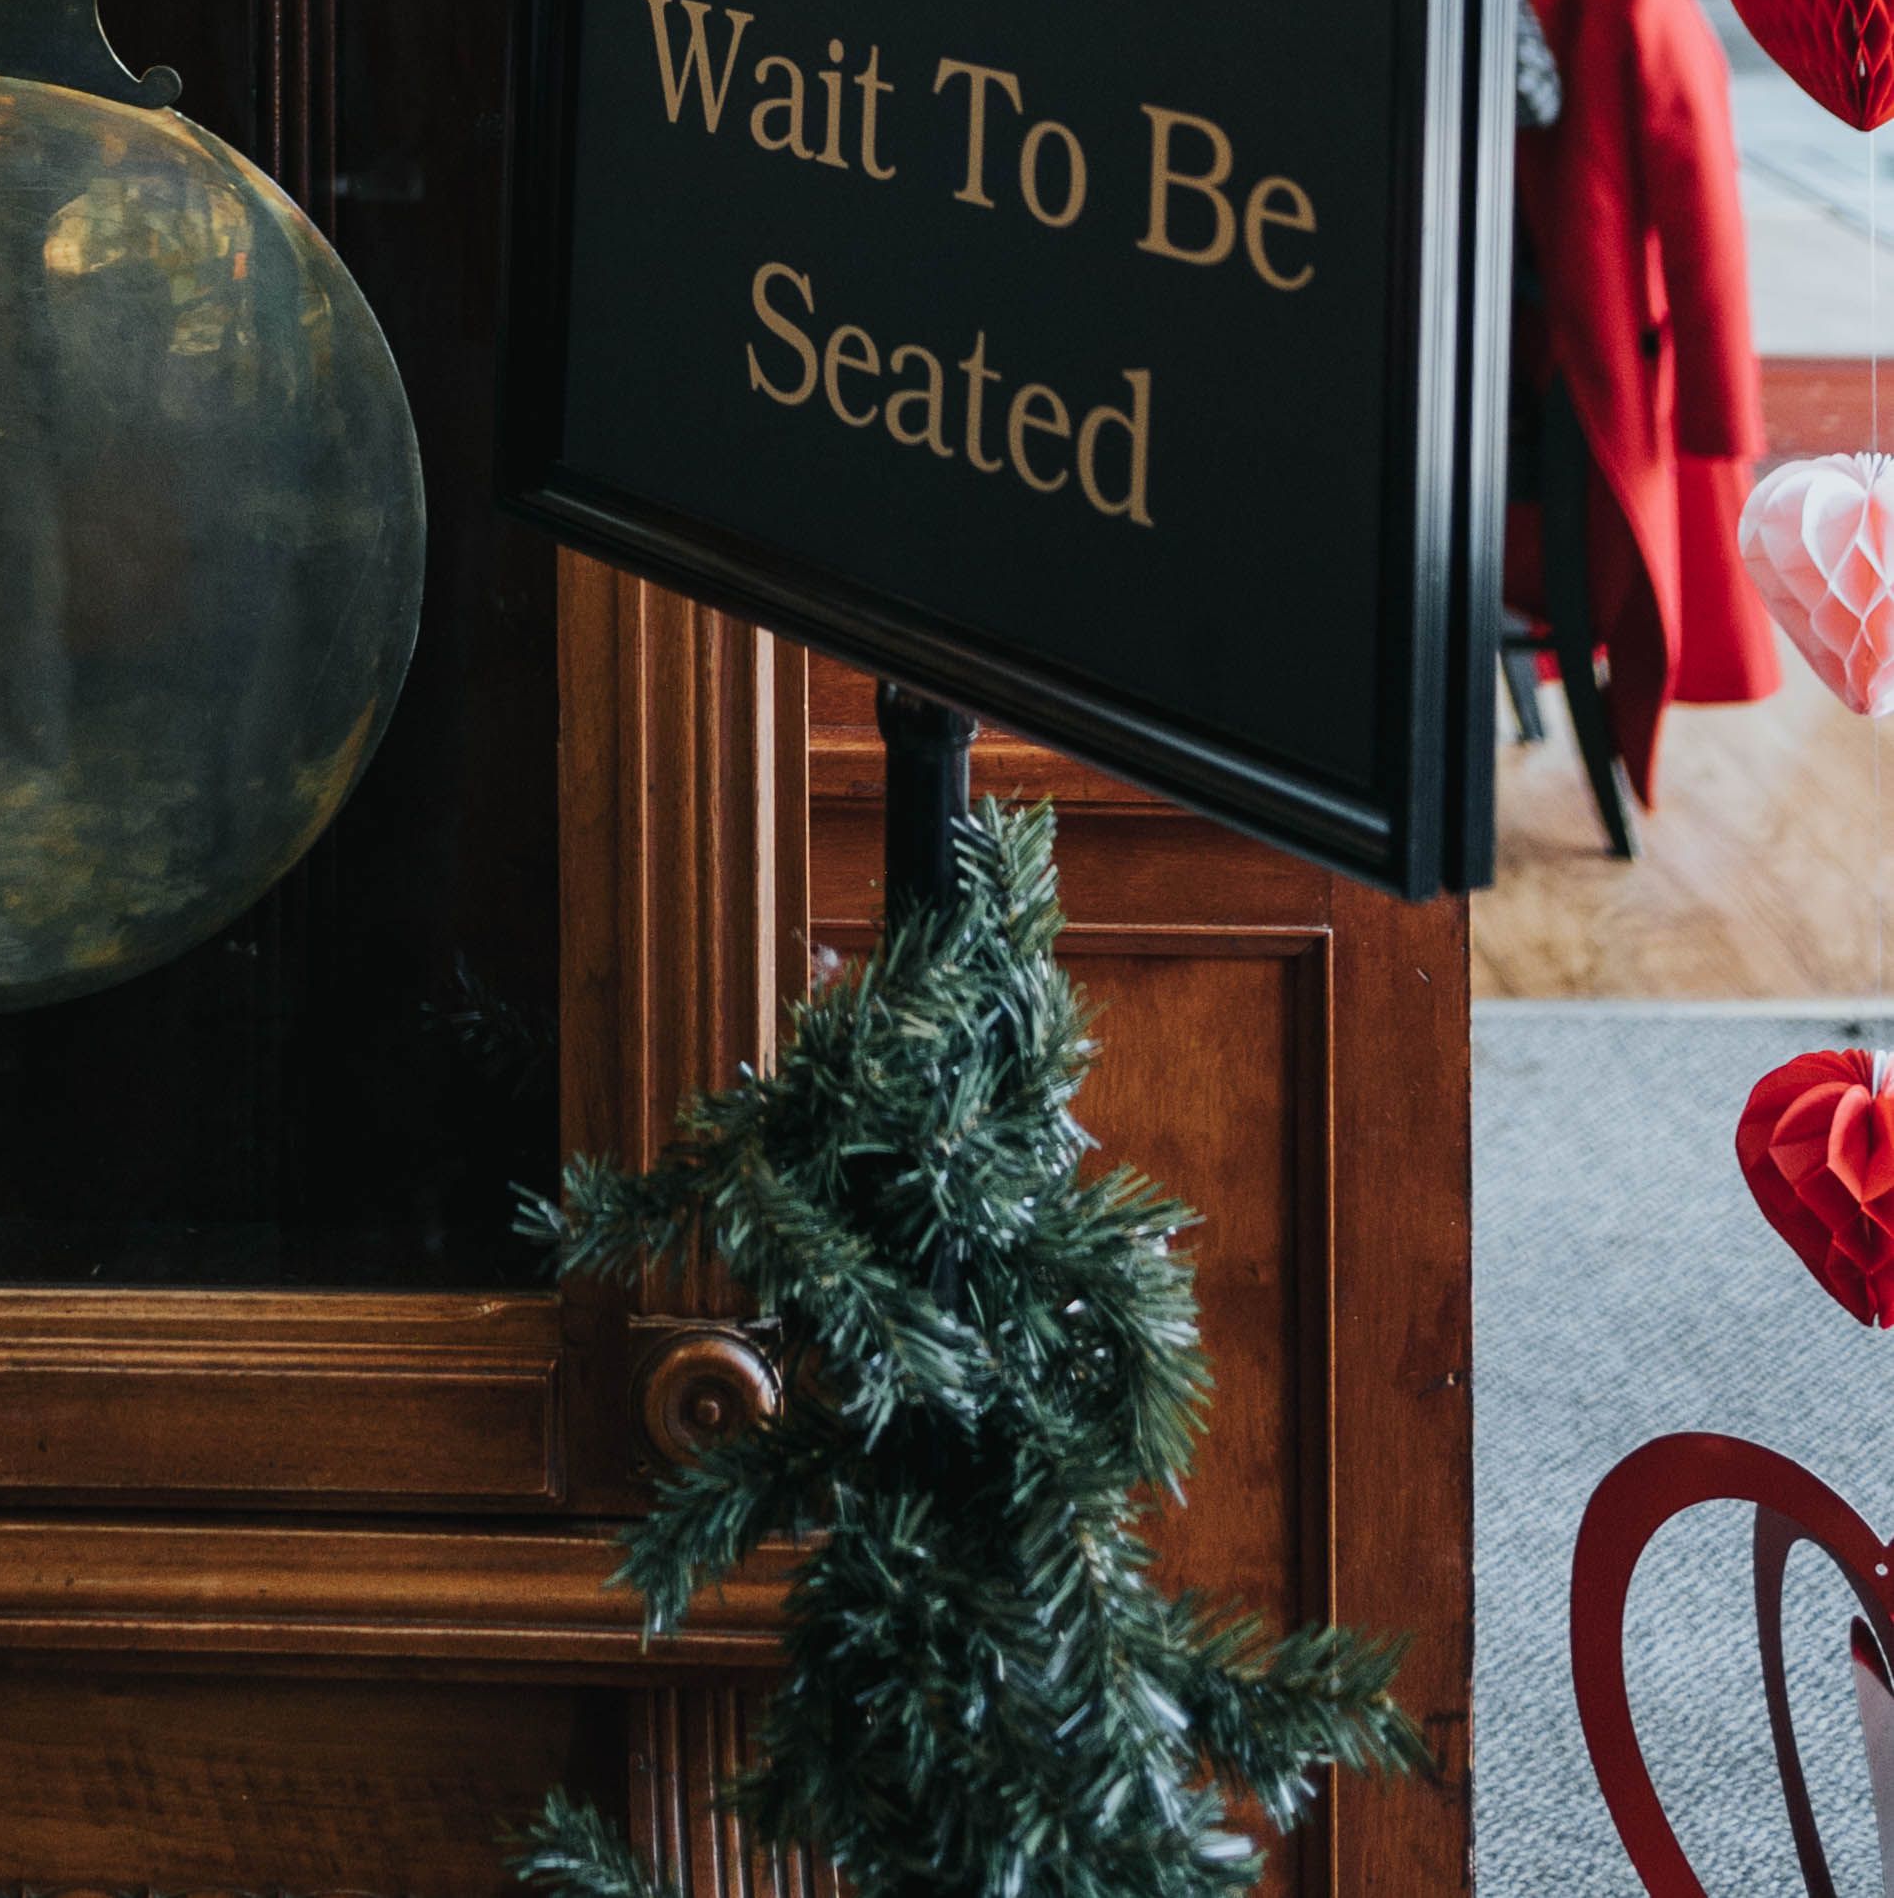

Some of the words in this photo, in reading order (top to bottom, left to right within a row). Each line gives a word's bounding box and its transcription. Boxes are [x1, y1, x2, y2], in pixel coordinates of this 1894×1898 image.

[932, 56, 1088, 229] To
[1136, 103, 1318, 292] Be
[746, 261, 1154, 528] Seated
